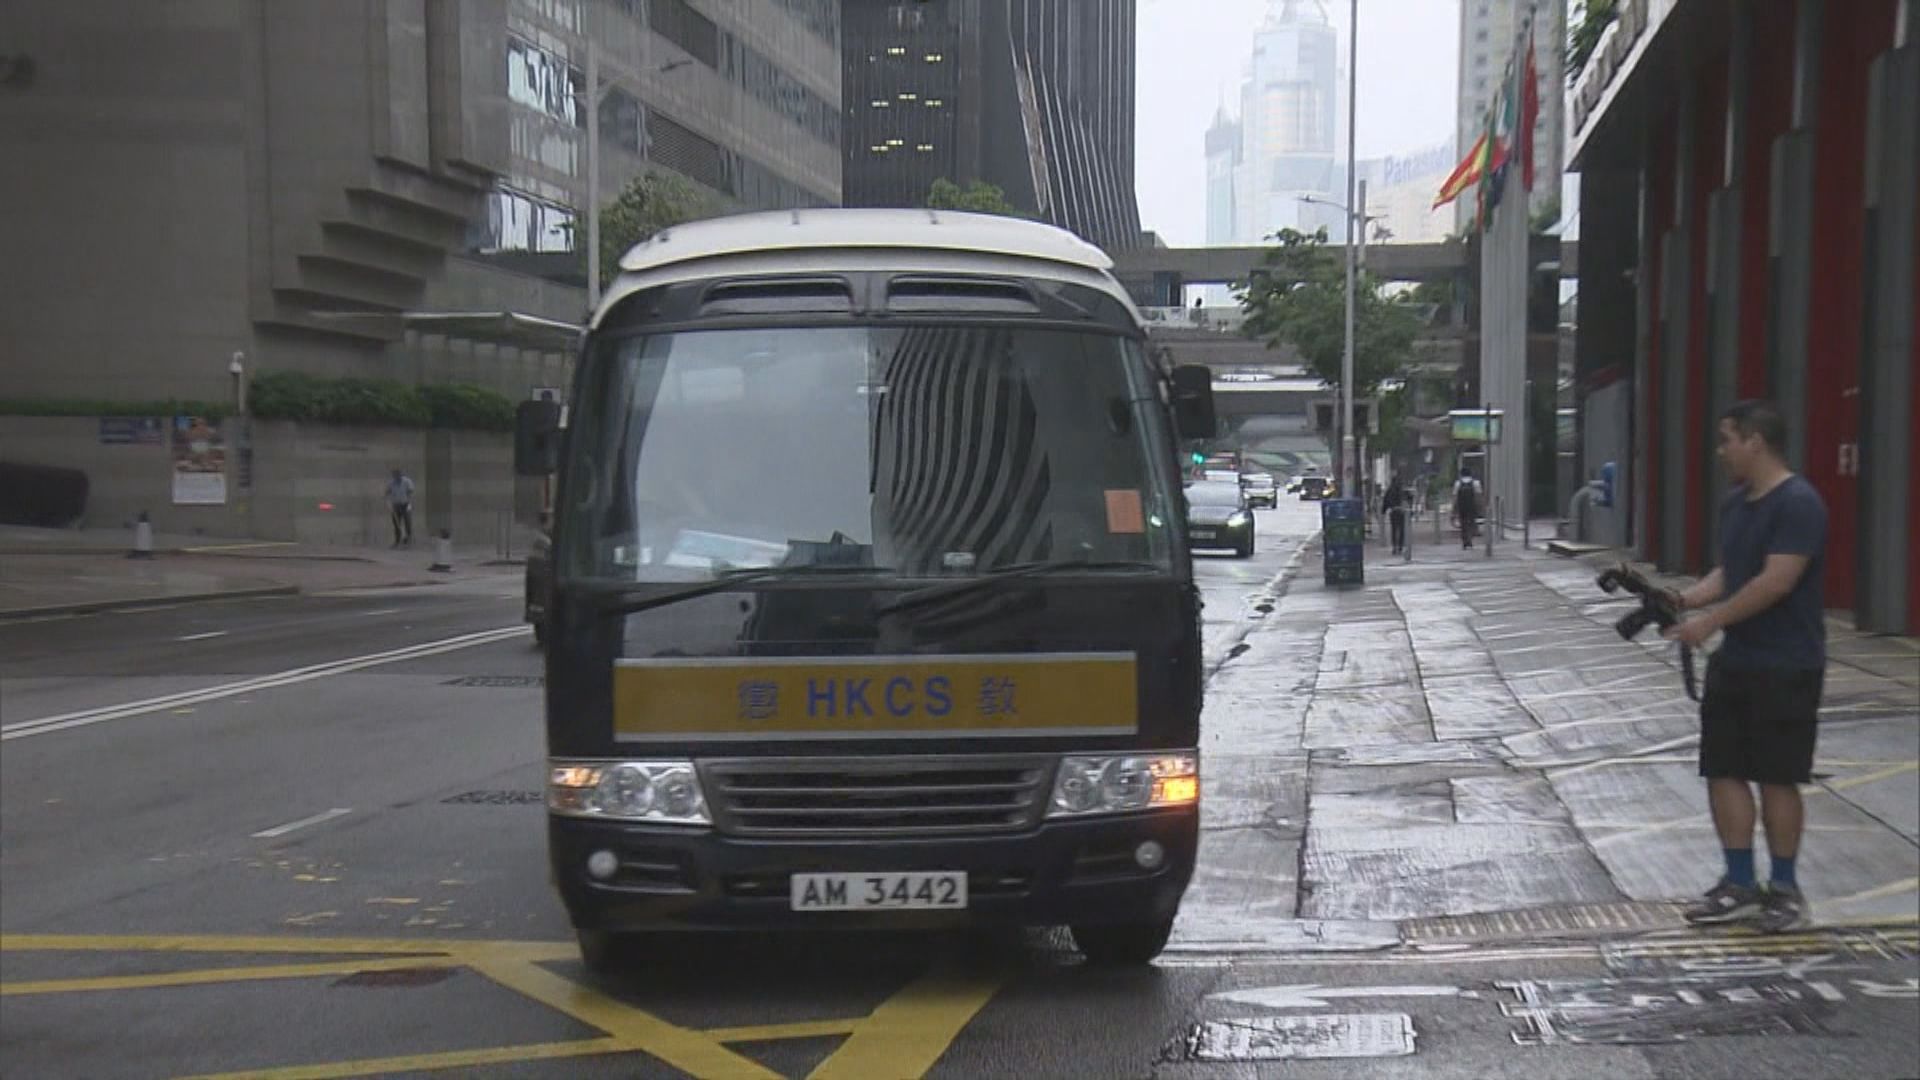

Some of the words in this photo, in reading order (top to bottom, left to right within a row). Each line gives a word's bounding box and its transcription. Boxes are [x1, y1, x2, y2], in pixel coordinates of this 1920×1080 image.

[807, 676, 953, 717] HKCS
[801, 878, 848, 905] AM
[864, 877, 958, 904] 3442
